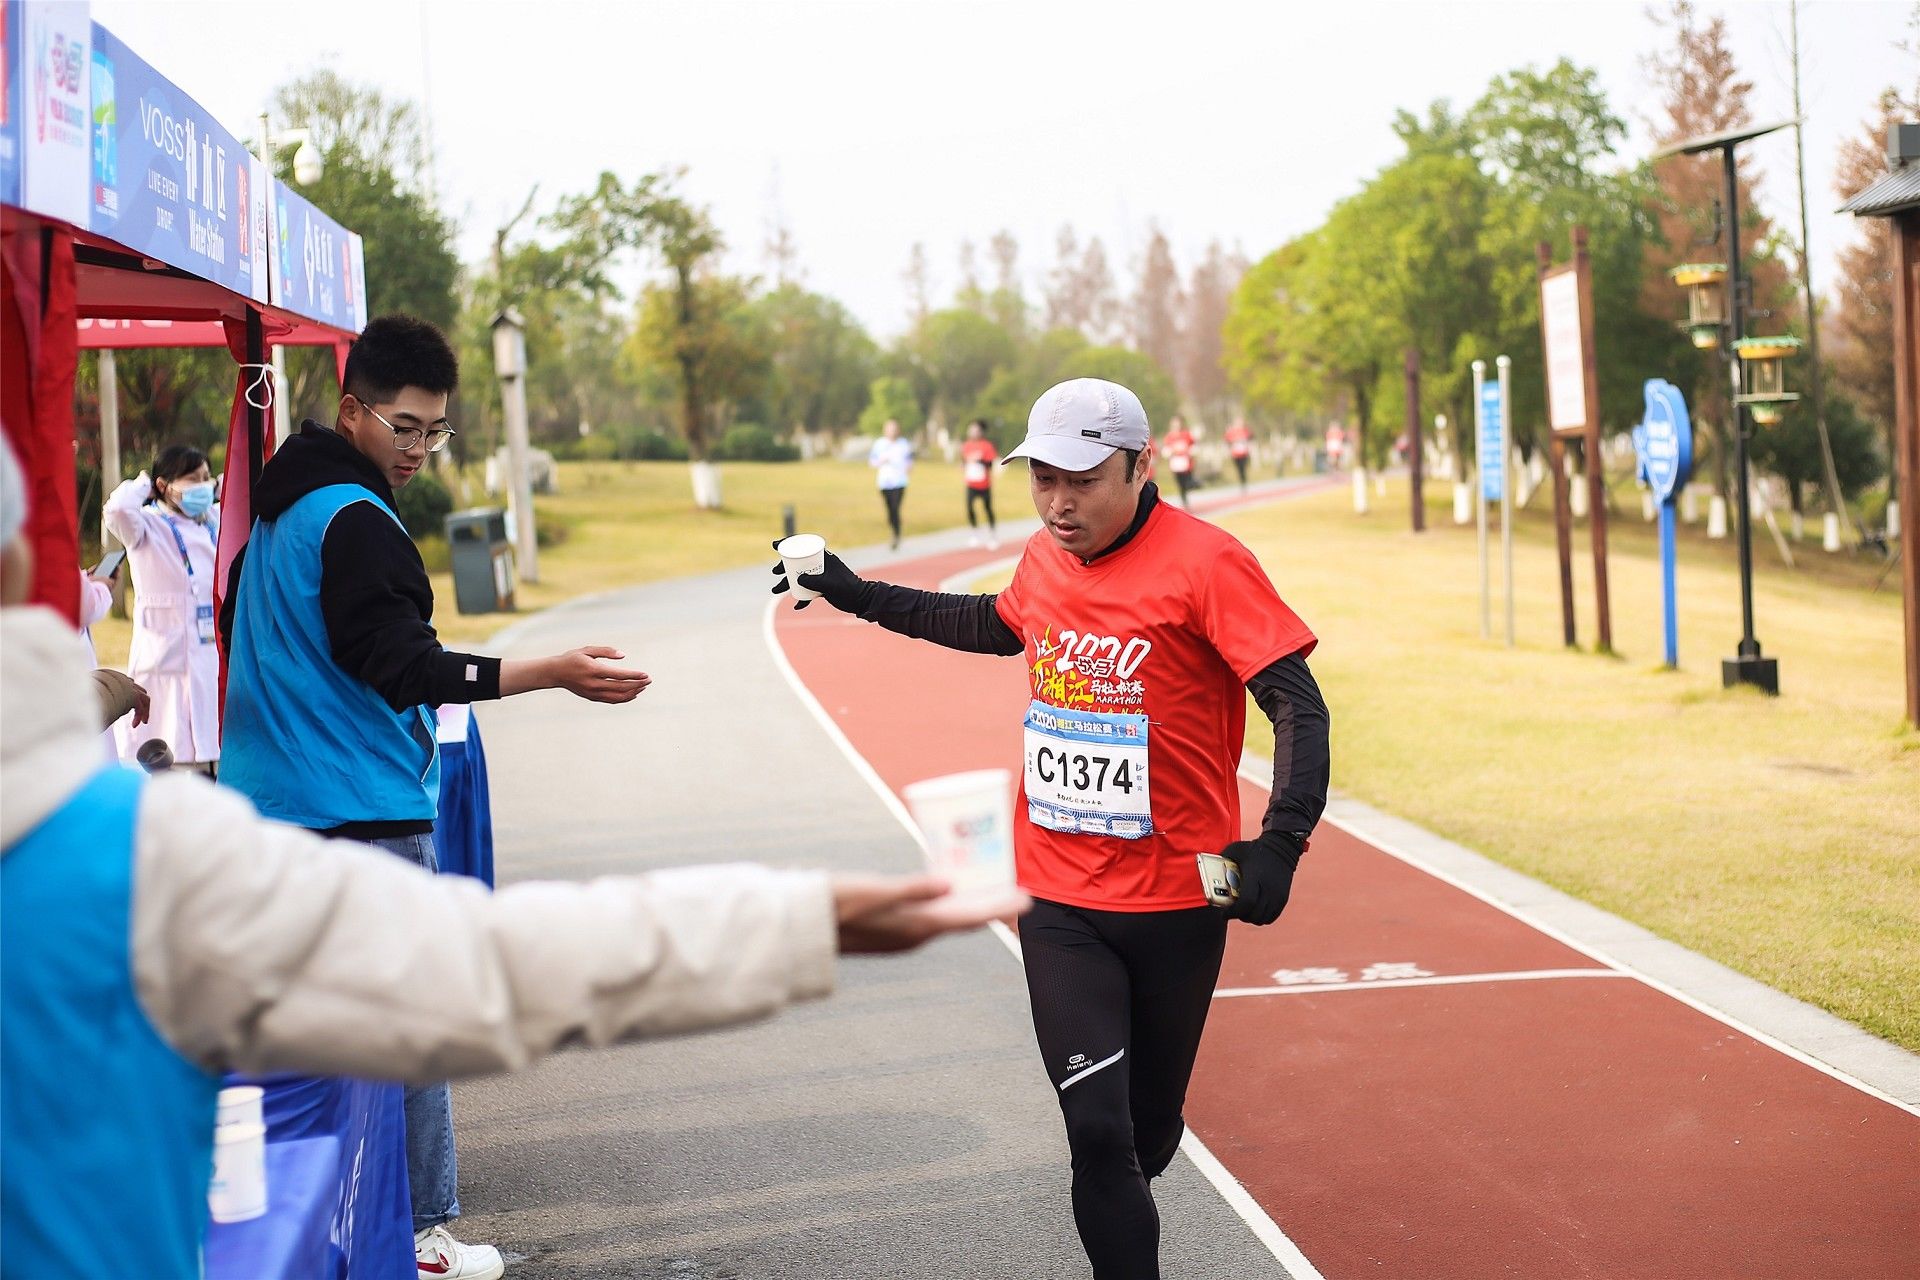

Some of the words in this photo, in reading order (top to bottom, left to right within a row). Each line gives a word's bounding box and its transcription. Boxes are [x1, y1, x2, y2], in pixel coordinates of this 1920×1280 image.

[140, 96, 184, 162] VOSS
[189, 207, 206, 256] Water
[207, 217, 225, 265] Station
[1056, 630, 1151, 680] 2020
[1042, 667, 1095, 703] 湘江
[1090, 680, 1145, 697] 马拉松赛
[1095, 694, 1142, 705] MARATHON
[1037, 746, 1133, 795] C1374
[1066, 1059, 1093, 1071] Kalenji
